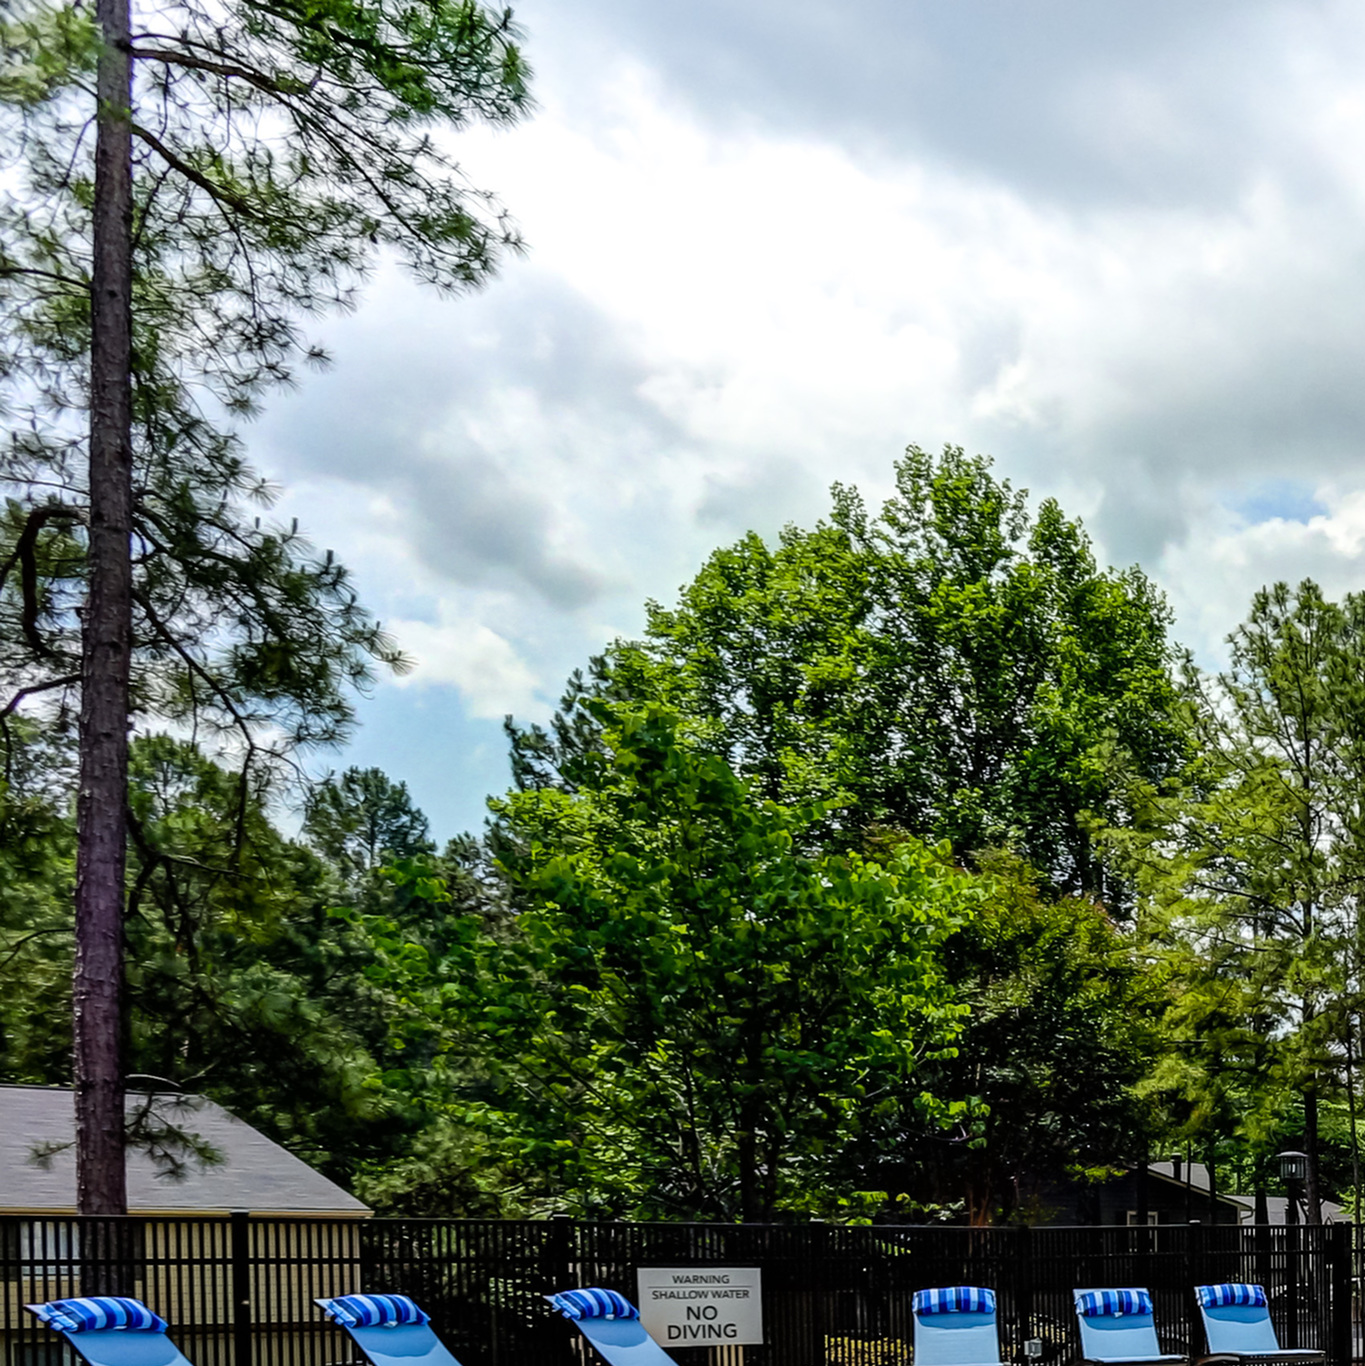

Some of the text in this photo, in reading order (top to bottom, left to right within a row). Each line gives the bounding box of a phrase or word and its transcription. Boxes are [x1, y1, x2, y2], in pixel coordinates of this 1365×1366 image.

[672, 1274, 730, 1285] WARNING
[652, 1289, 750, 1300] SHALLOW WATER
[686, 1305, 718, 1321] NO
[667, 1323, 738, 1340] DIVING
